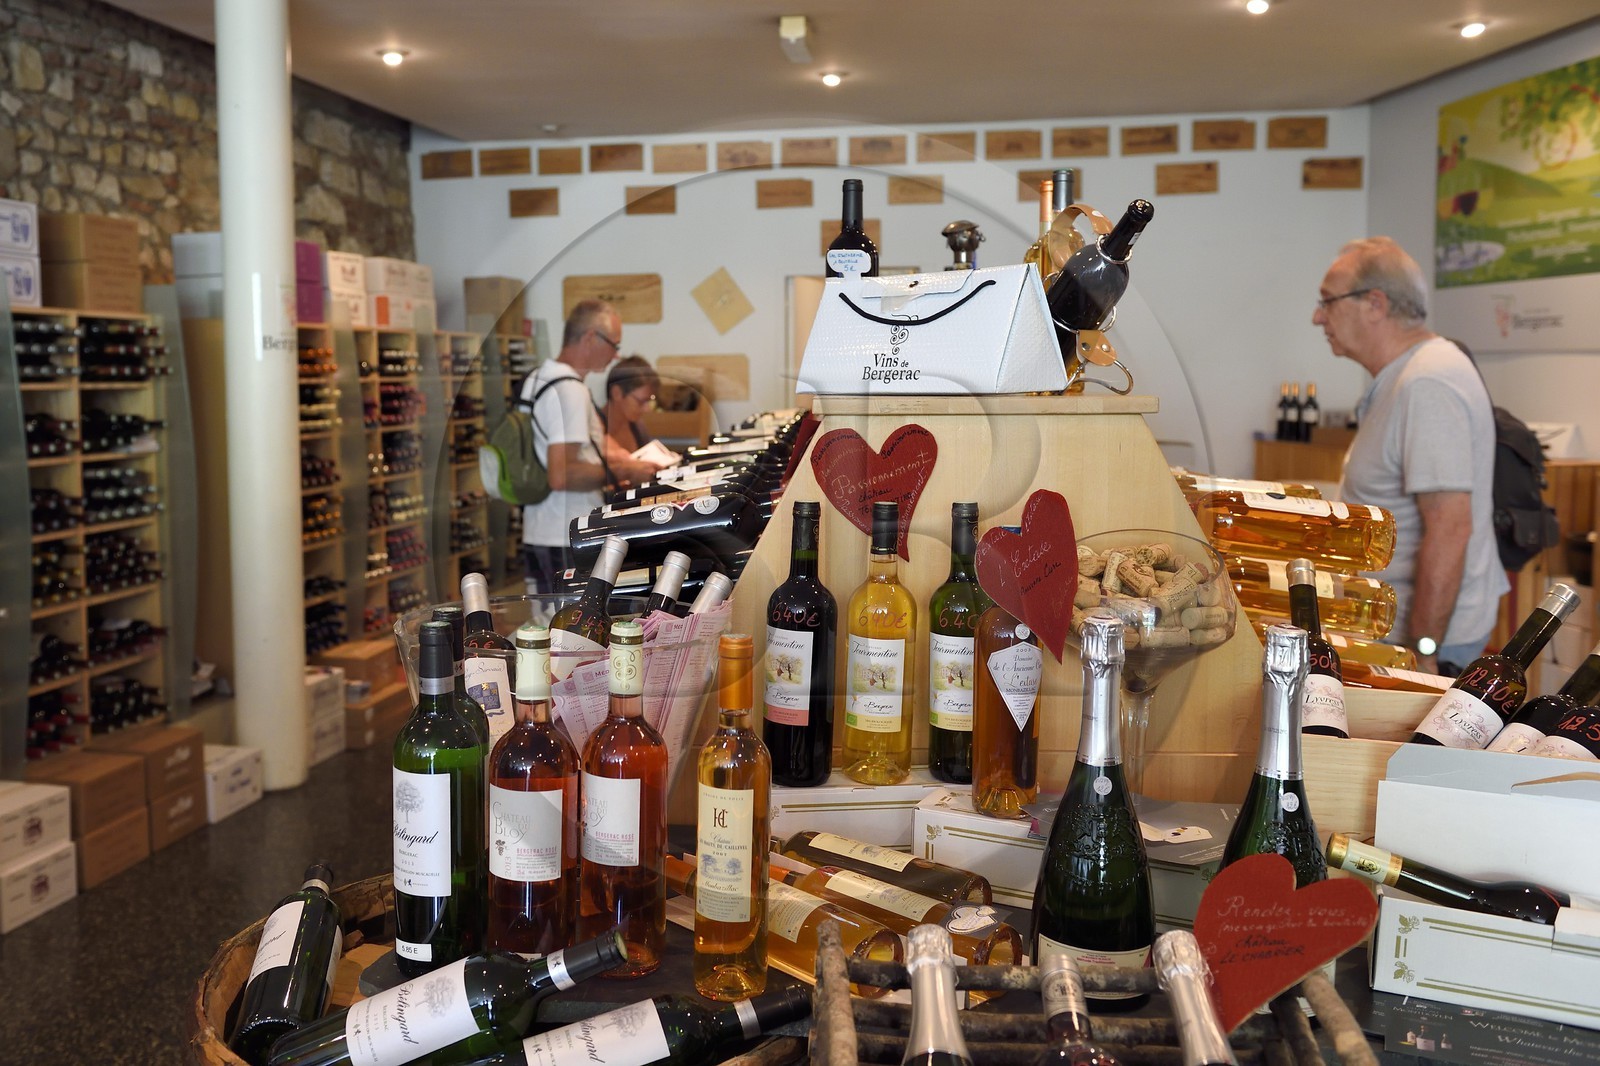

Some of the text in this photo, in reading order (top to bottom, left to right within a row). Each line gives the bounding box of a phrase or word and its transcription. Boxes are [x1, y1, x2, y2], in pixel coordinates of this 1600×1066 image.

[873, 353, 909, 368] Vins de
[862, 366, 921, 384] Bergerac
[852, 640, 899, 658] Tourmentine
